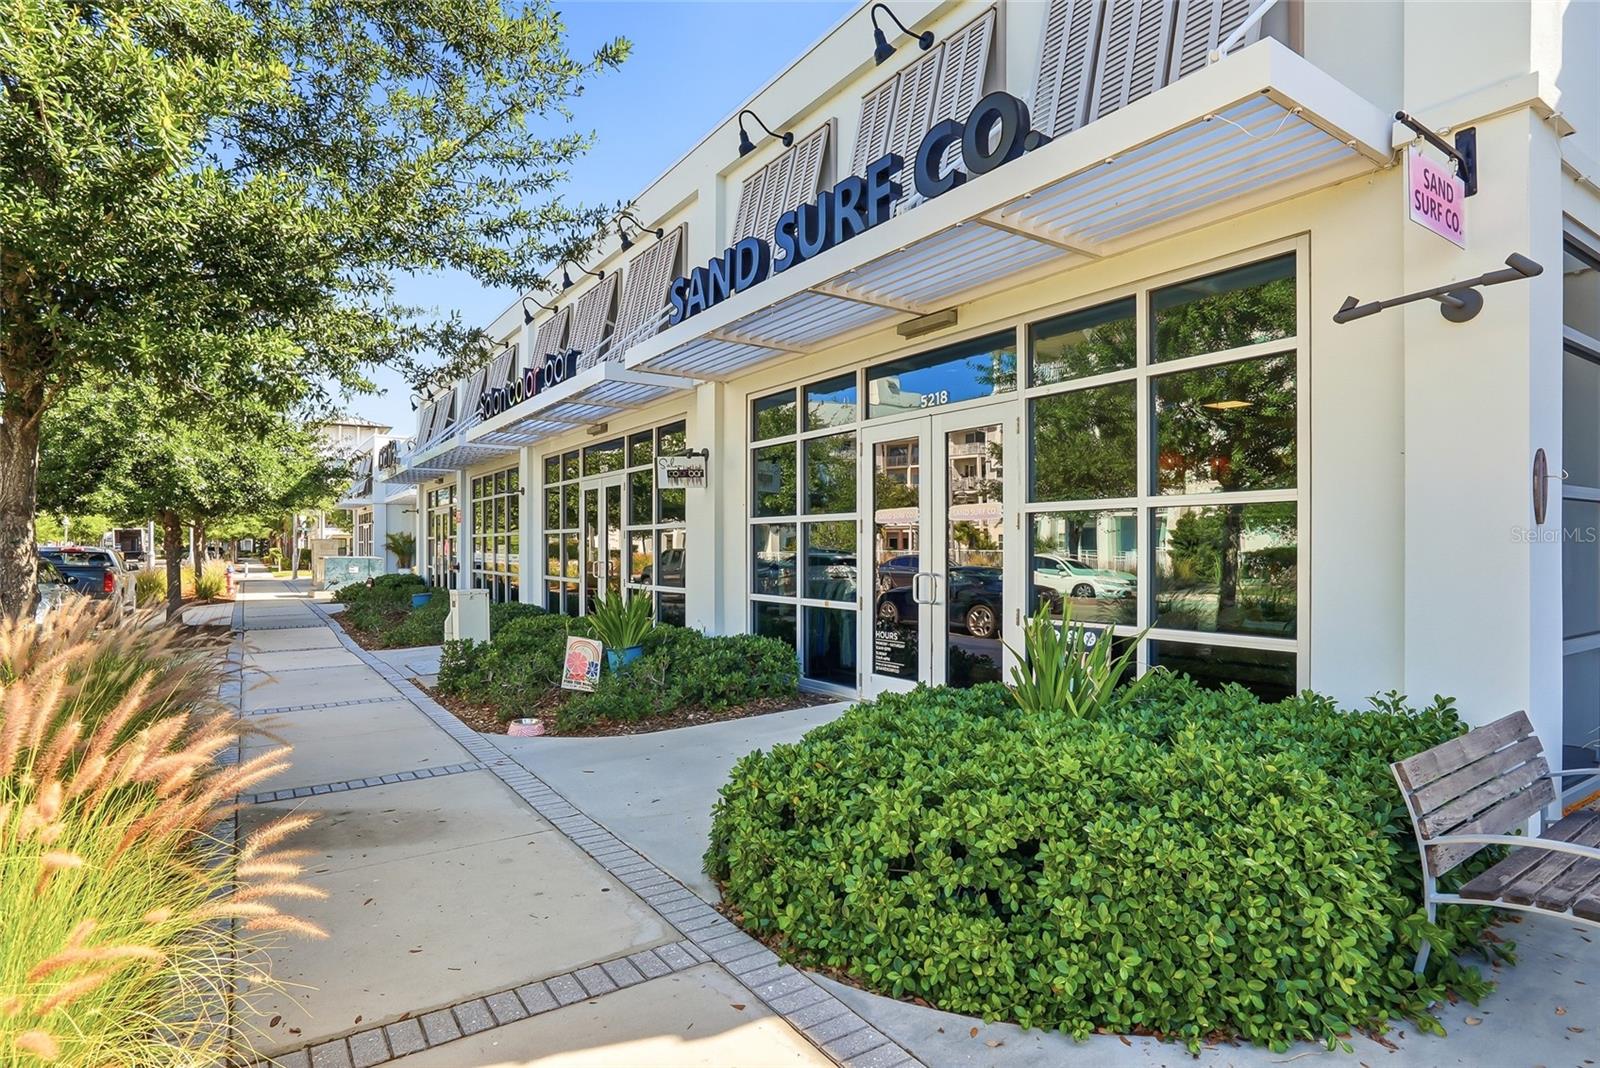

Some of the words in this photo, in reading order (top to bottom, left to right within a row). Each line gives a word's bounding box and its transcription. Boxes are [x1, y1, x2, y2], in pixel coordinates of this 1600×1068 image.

[1423, 168, 1454, 204] SAND
[669, 236, 770, 327] SAND
[773, 152, 903, 272] SURF
[914, 91, 1053, 198] CO.
[1414, 189, 1443, 223] SURF
[1445, 208, 1462, 236] CO.
[508, 367, 541, 407] color
[920, 390, 949, 408] 5218
[875, 630, 899, 640] HOURS
